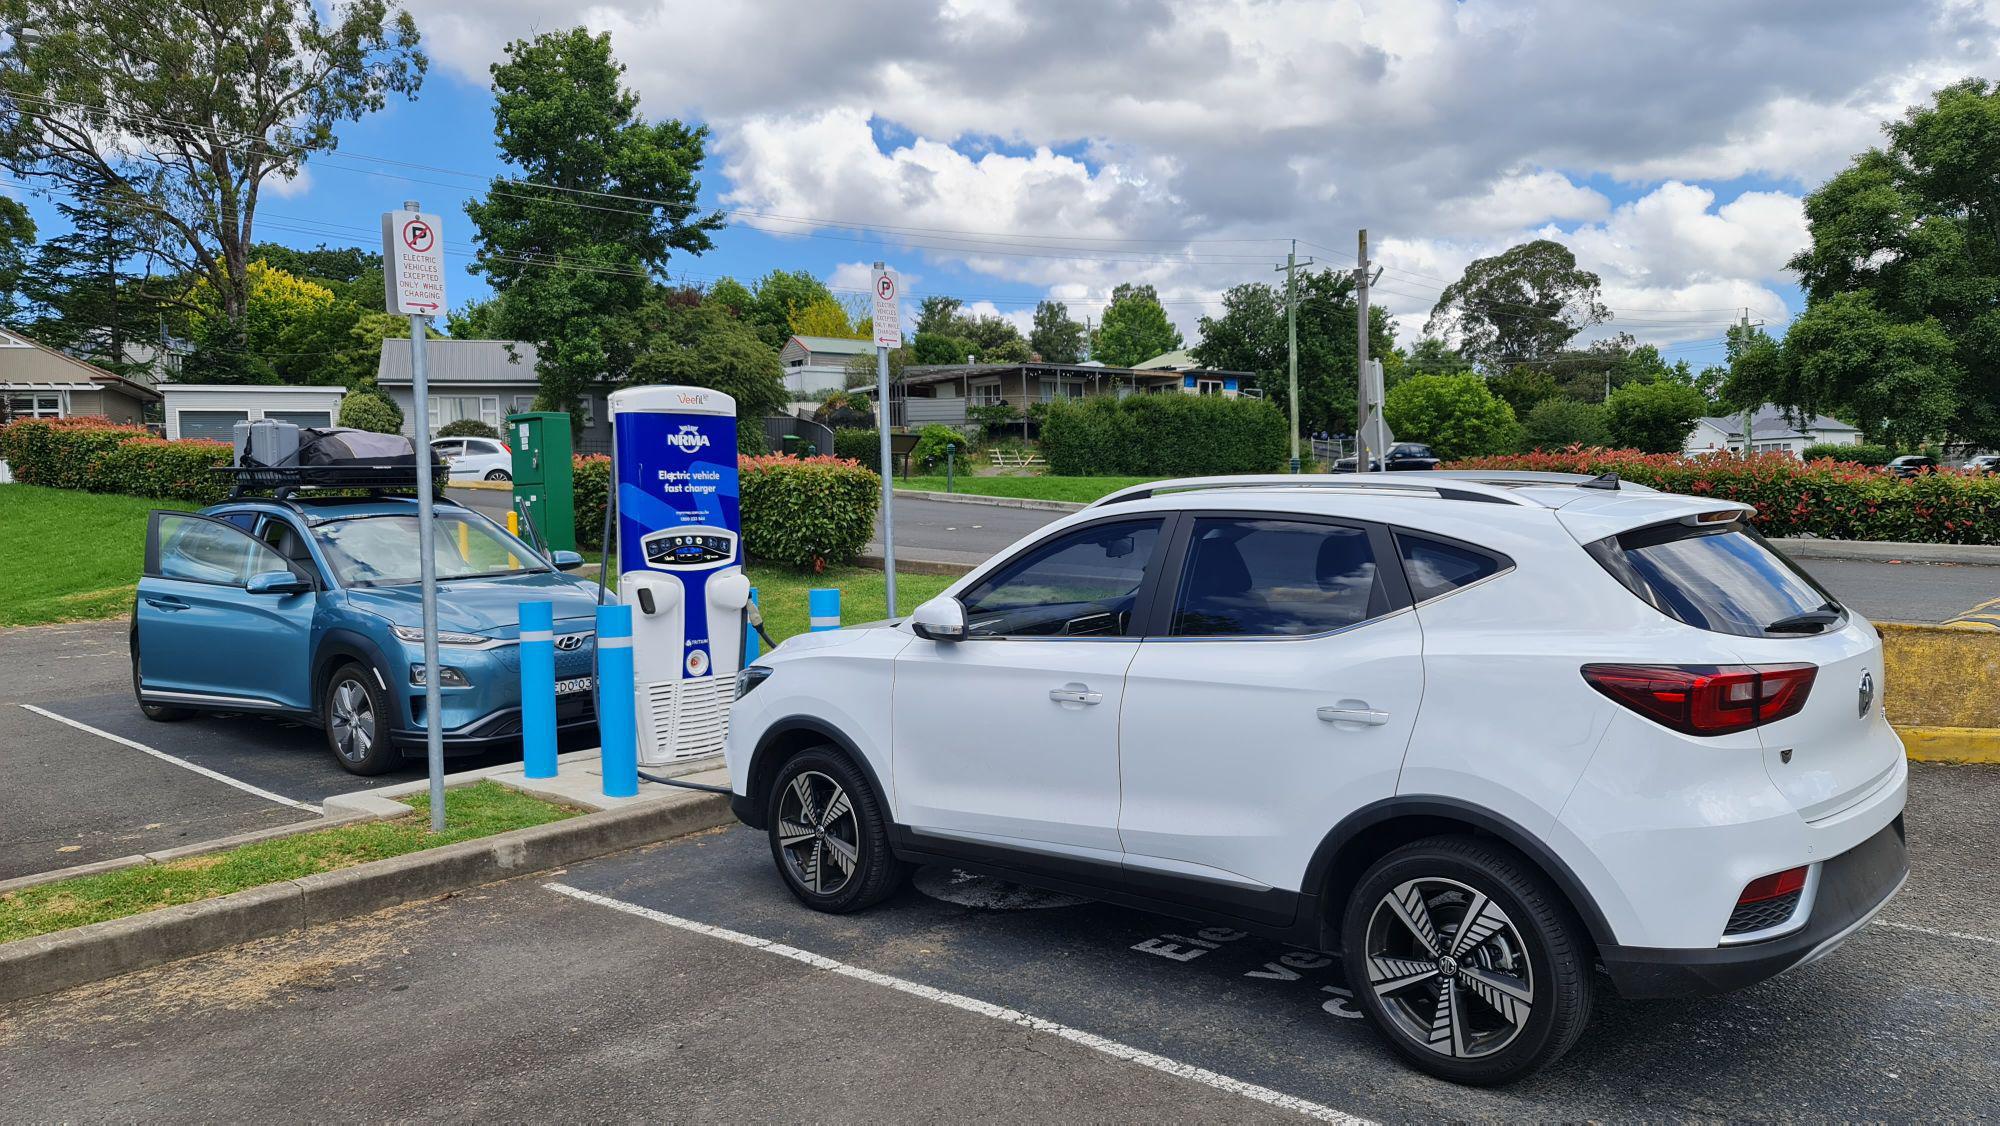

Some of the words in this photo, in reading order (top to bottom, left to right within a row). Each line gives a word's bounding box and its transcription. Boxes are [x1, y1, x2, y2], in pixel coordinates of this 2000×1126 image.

[403, 253, 436, 264] ELECTRIC
[403, 263, 438, 273] VEHICLES
[403, 271, 439, 282] EXCEPTED
[399, 280, 419, 288] ONLY
[422, 282, 443, 291] WHILE
[404, 289, 440, 299] CHARGING
[667, 434, 710, 447] NRMA
[658, 470, 691, 480] Electric
[692, 470, 720, 480] vehicle
[664, 483, 683, 493] fast
[684, 483, 716, 495] charger
[1440, 957, 1456, 975] MG
